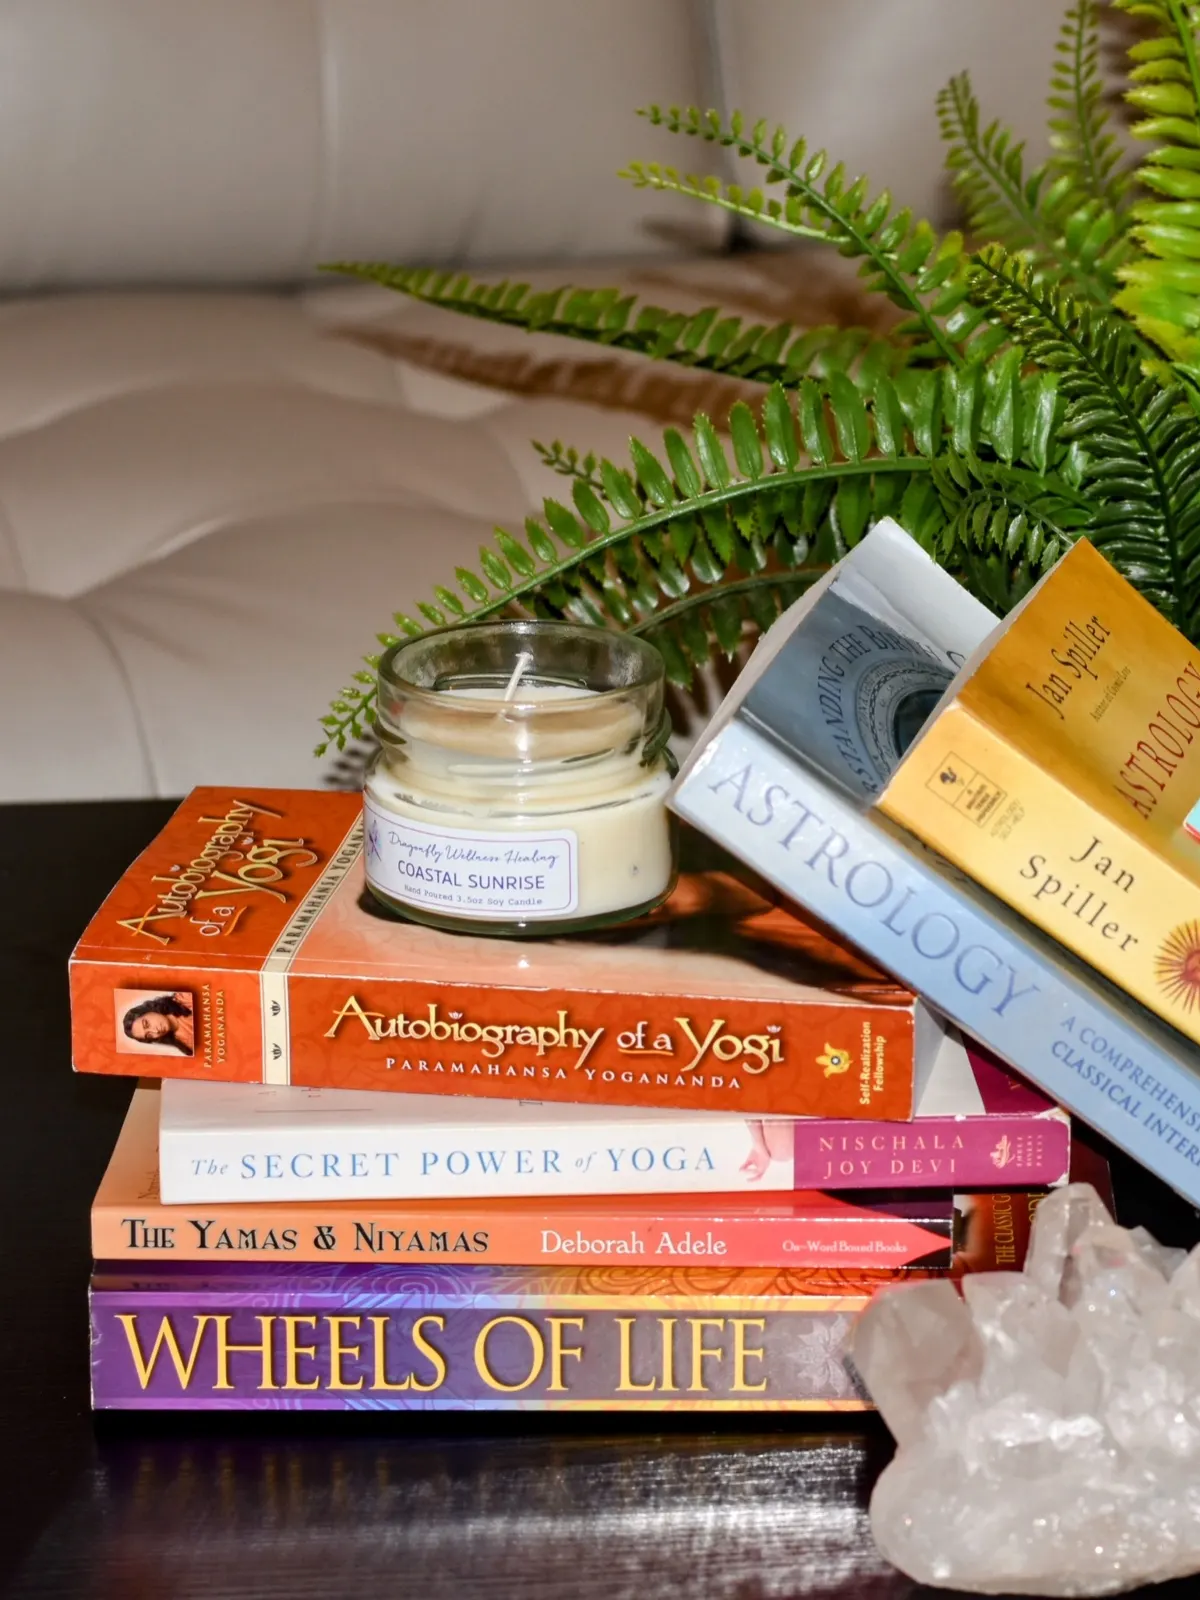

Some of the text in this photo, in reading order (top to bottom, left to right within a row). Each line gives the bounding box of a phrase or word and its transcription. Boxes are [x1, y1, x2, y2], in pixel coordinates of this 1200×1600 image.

[829, 633, 871, 664] THE
[1026, 615, 1111, 720] Jan Spiller
[116, 799, 282, 946] Autobiography
[388, 831, 559, 868] Dragonfly Wellness Healing
[1070, 836, 1135, 893] Jan
[190, 837, 319, 937] of a Yogi
[397, 860, 546, 890] COASTAL SUNRISE
[404, 884, 543, 906] Hand Poured 3.5oz Soy Candle
[708, 763, 1041, 1017] ASTROLOGY
[276, 874, 341, 953] PARAMAHANSA
[1020, 854, 1139, 953] Spiller
[203, 984, 212, 1069] PARAMAHANSA
[216, 990, 225, 1064] YOGANANDA
[324, 995, 785, 1074] Autobiography of a Yogi
[1060, 1016, 1077, 1033] A
[386, 1058, 741, 1089] PARAMAHANSA YOGANANDA
[859, 1021, 872, 1105] Self-Realization
[873, 1035, 887, 1092] Fellowship
[1052, 1040, 1142, 1118] CLASSICAL
[191, 1159, 229, 1177] The
[240, 1152, 399, 1179] SECRET
[420, 1150, 562, 1176] POWER
[575, 1152, 598, 1173] of
[607, 1146, 716, 1172] YOGA
[818, 1134, 965, 1151] NISCHALA
[823, 1159, 956, 1179] JOY DEVI
[121, 1218, 489, 1254] THE YAMAS & NIYAMAS
[541, 1230, 728, 1256] Deborah Adele
[839, 1241, 874, 1253] Bound
[875, 1241, 908, 1254] Books
[993, 1205, 1015, 1243] CLASSIC
[996, 1245, 1016, 1265] THE
[114, 1314, 768, 1393] WHEELS OF LIFE
